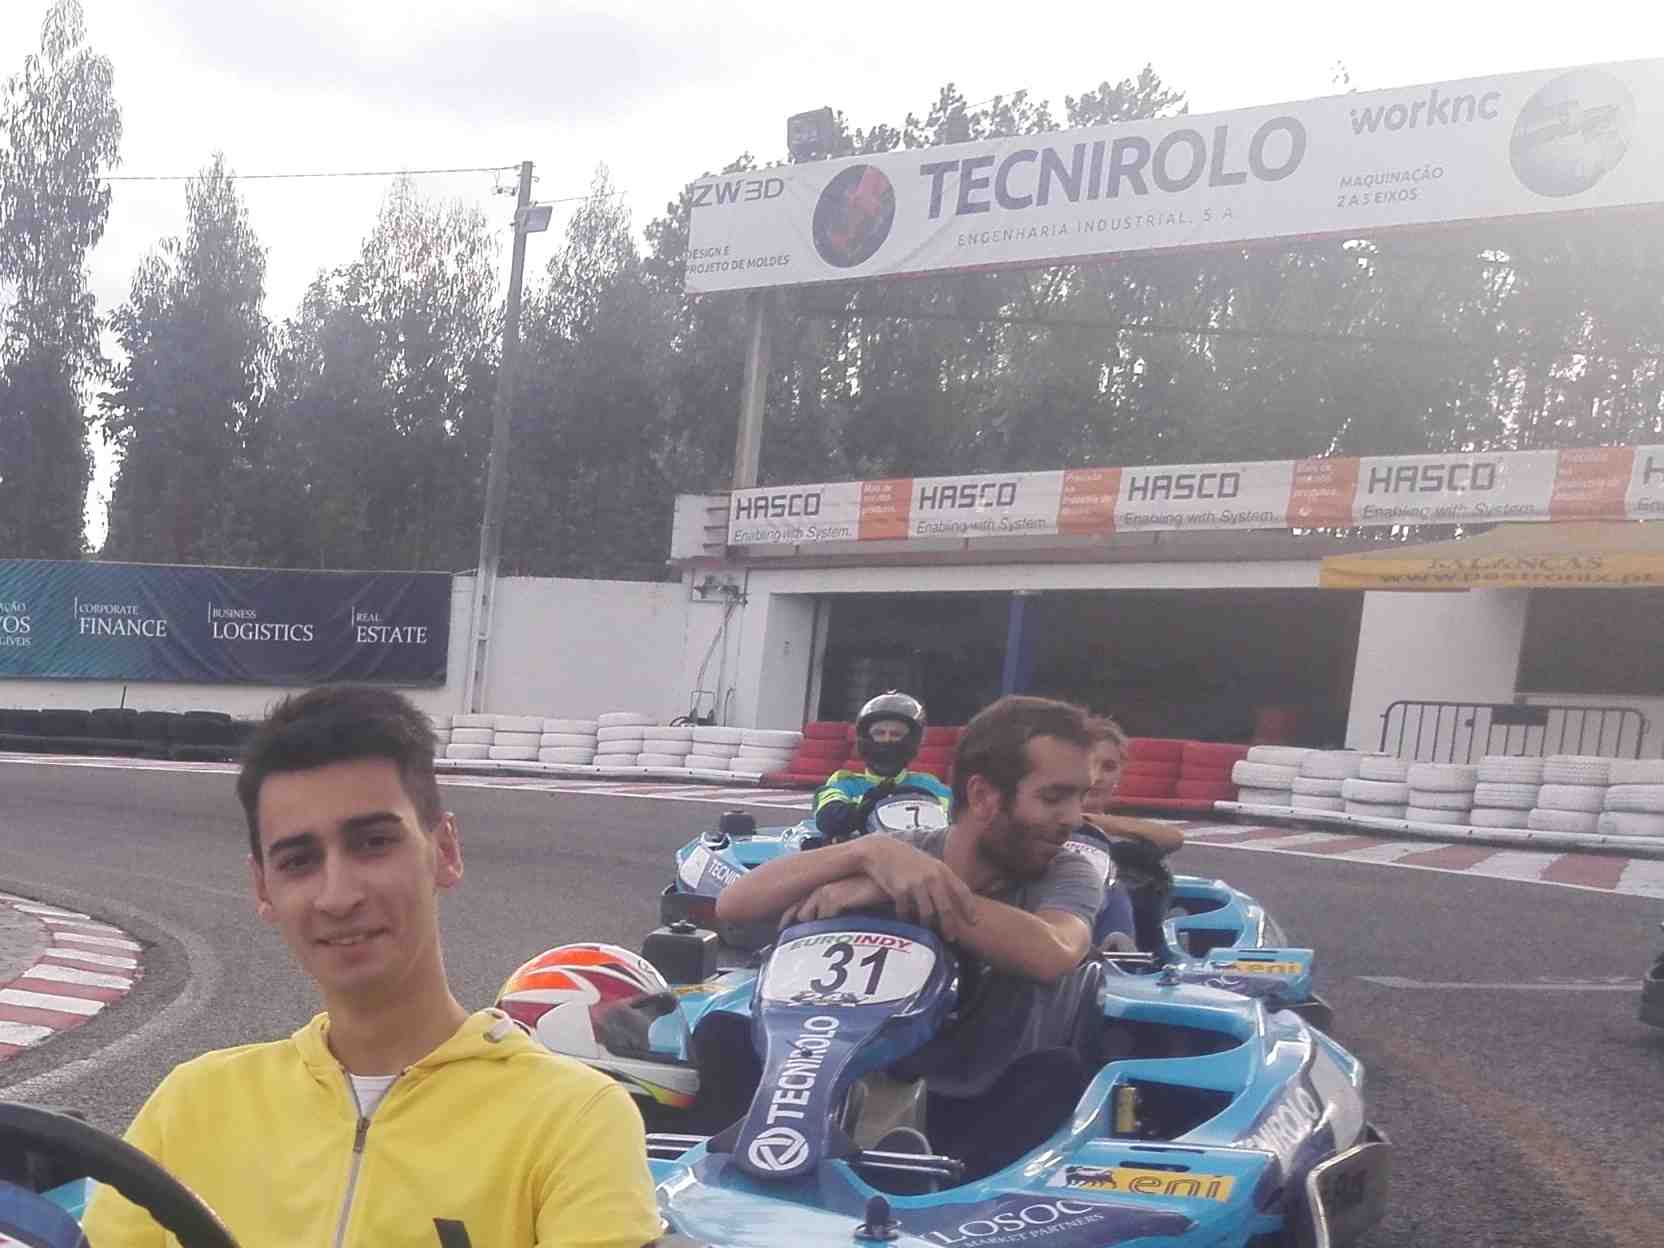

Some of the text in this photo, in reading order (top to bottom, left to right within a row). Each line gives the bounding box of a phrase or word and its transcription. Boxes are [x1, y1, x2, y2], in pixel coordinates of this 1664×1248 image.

[1349, 88, 1501, 135] worknc
[919, 116, 1306, 220] TECNIROLO
[1374, 188, 1418, 204] EIXOS
[957, 223, 1069, 247] ENGENHARIA
[731, 259, 746, 270] DE
[747, 254, 792, 268] MOLDES
[1128, 472, 1240, 501] HASCO
[1368, 463, 1496, 494] HASCO
[736, 493, 821, 520] HASCO
[919, 482, 1017, 510] HASCO
[79, 604, 139, 616] CORPORATE
[213, 608, 257, 619] BUSINESS
[356, 611, 381, 623] REAL
[79, 616, 168, 637] FINANCE
[212, 622, 314, 641] LOGISTICS
[356, 626, 429, 644] ESTATE
[905, 806, 921, 828] 7
[811, 942, 889, 995] 31
[767, 1015, 840, 1124] TECNIROLO
[1128, 1176, 1221, 1198] eni
[964, 1214, 1105, 1248] MARKET PARTNERS
